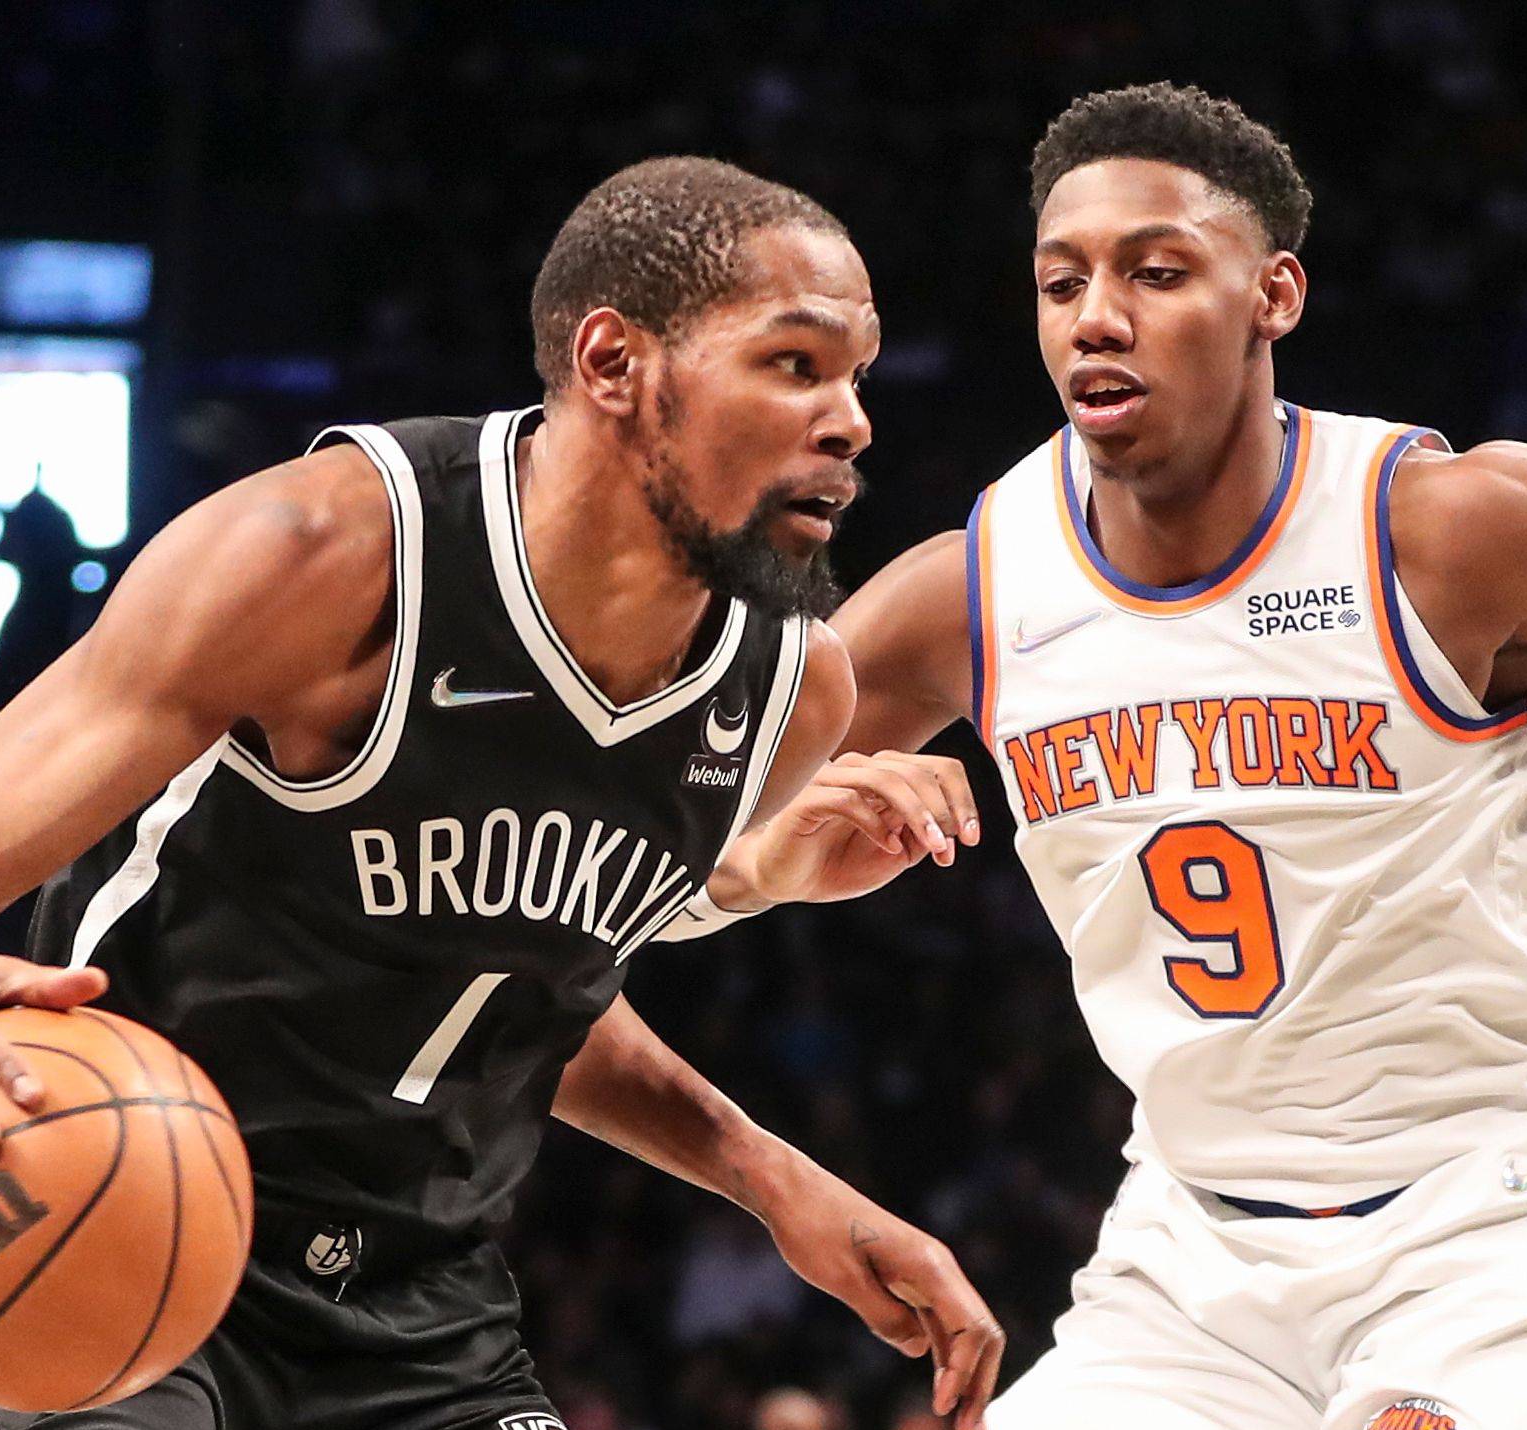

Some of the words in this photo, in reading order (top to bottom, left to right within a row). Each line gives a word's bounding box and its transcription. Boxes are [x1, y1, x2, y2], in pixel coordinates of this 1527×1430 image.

[1247, 585, 1355, 615] SQUARE
[1249, 611, 1335, 637] SPACE
[687, 763, 740, 788] Webull
[1005, 704, 1164, 826] NEW
[1170, 695, 1401, 793] YORK
[1137, 819, 1285, 1020] 9
